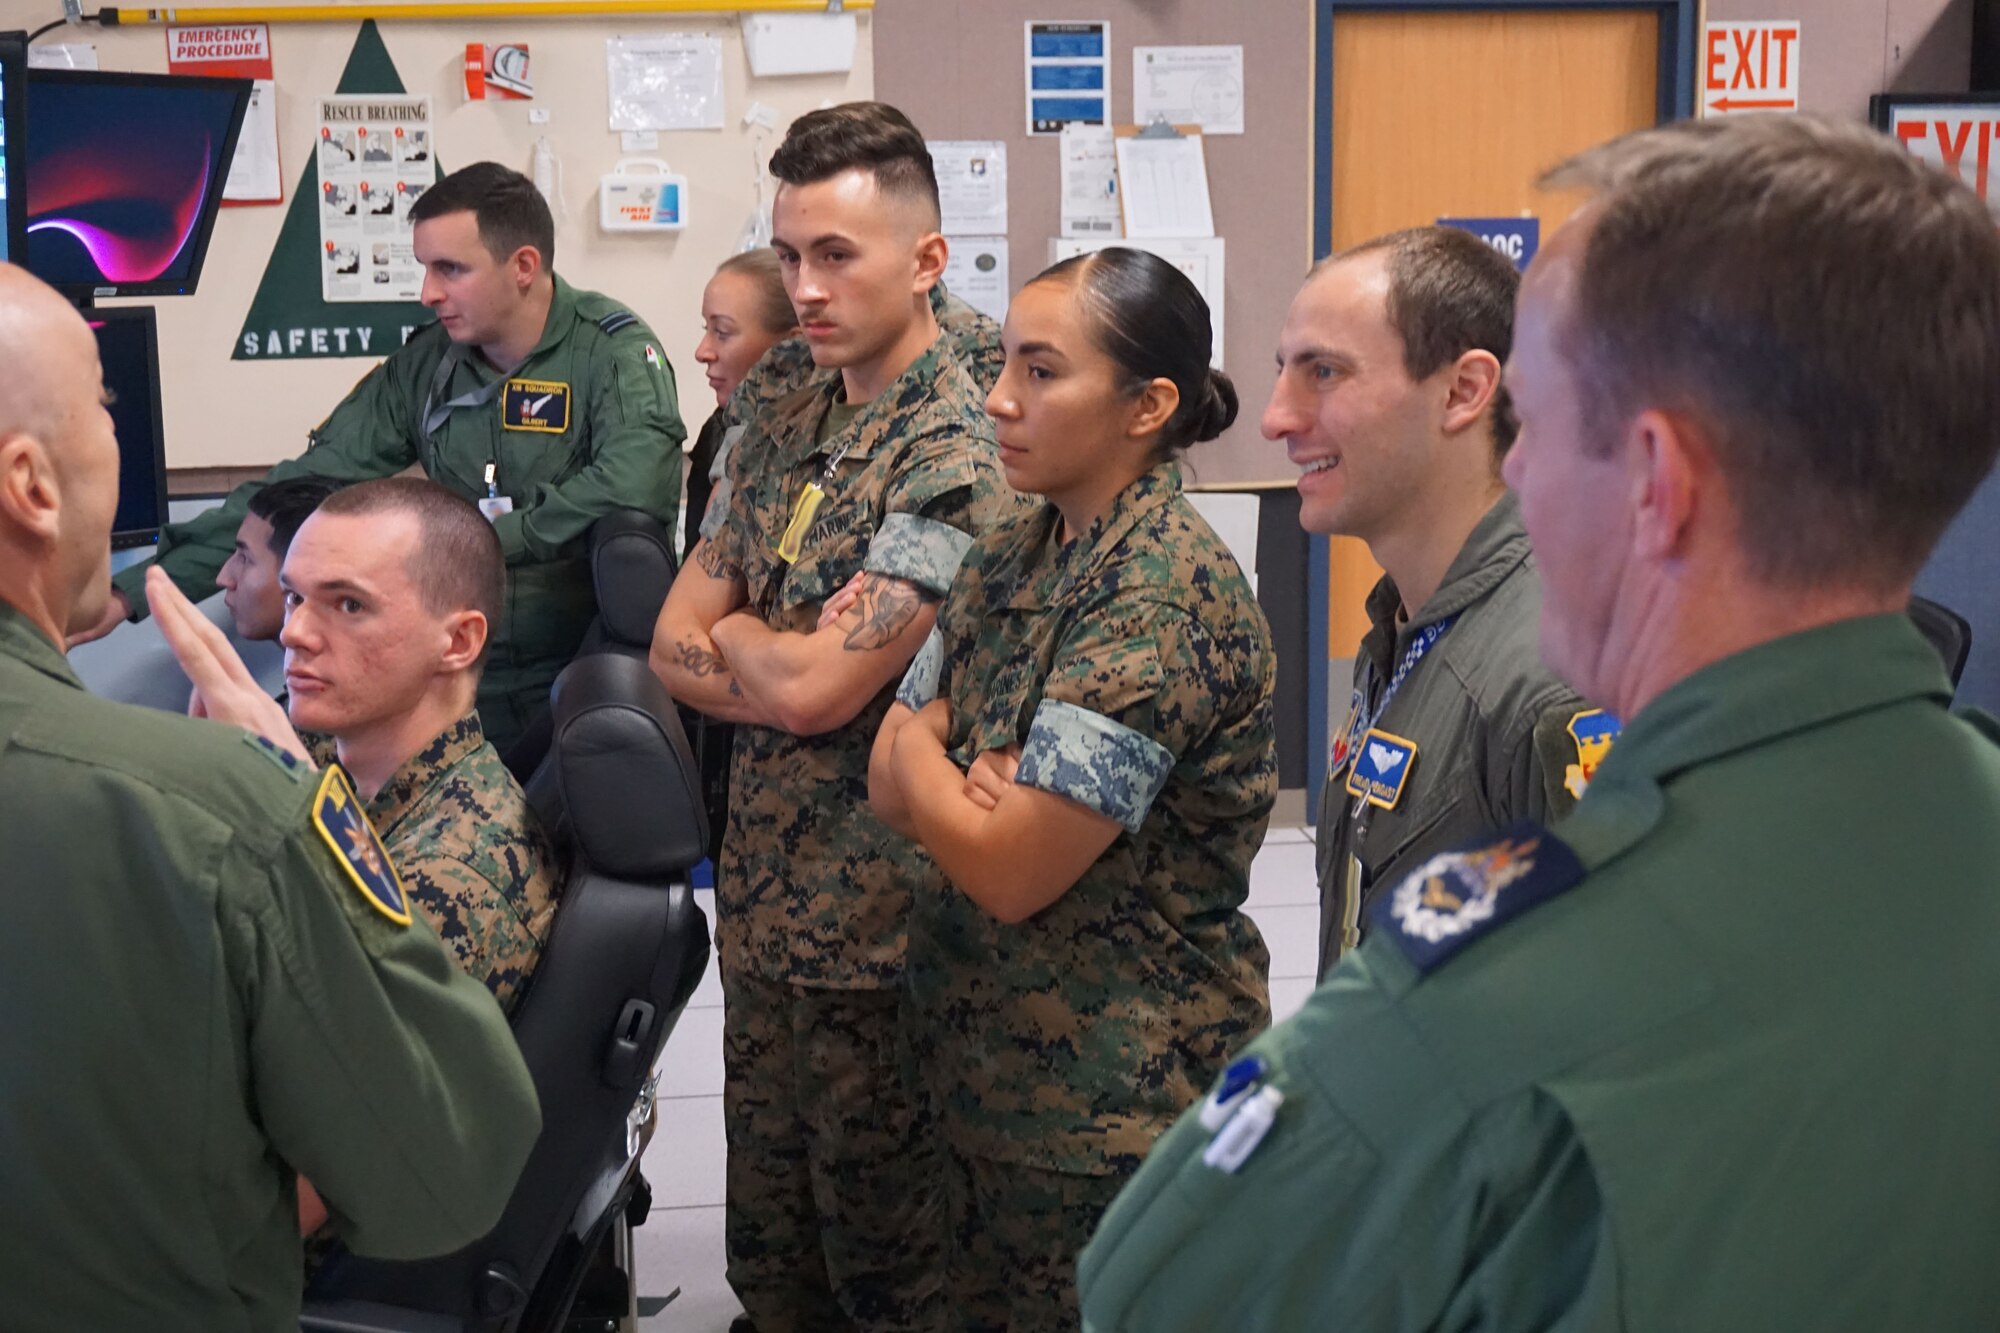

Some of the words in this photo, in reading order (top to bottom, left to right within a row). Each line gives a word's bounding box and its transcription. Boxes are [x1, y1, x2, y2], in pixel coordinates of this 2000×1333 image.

[178, 28, 257, 43] EMERGENCY
[177, 42, 262, 58] PROCEDURE
[1706, 29, 1797, 90] EXIT
[323, 104, 362, 121] RESCUE
[368, 103, 426, 121] BREATHING
[243, 326, 373, 356] SAFETY
